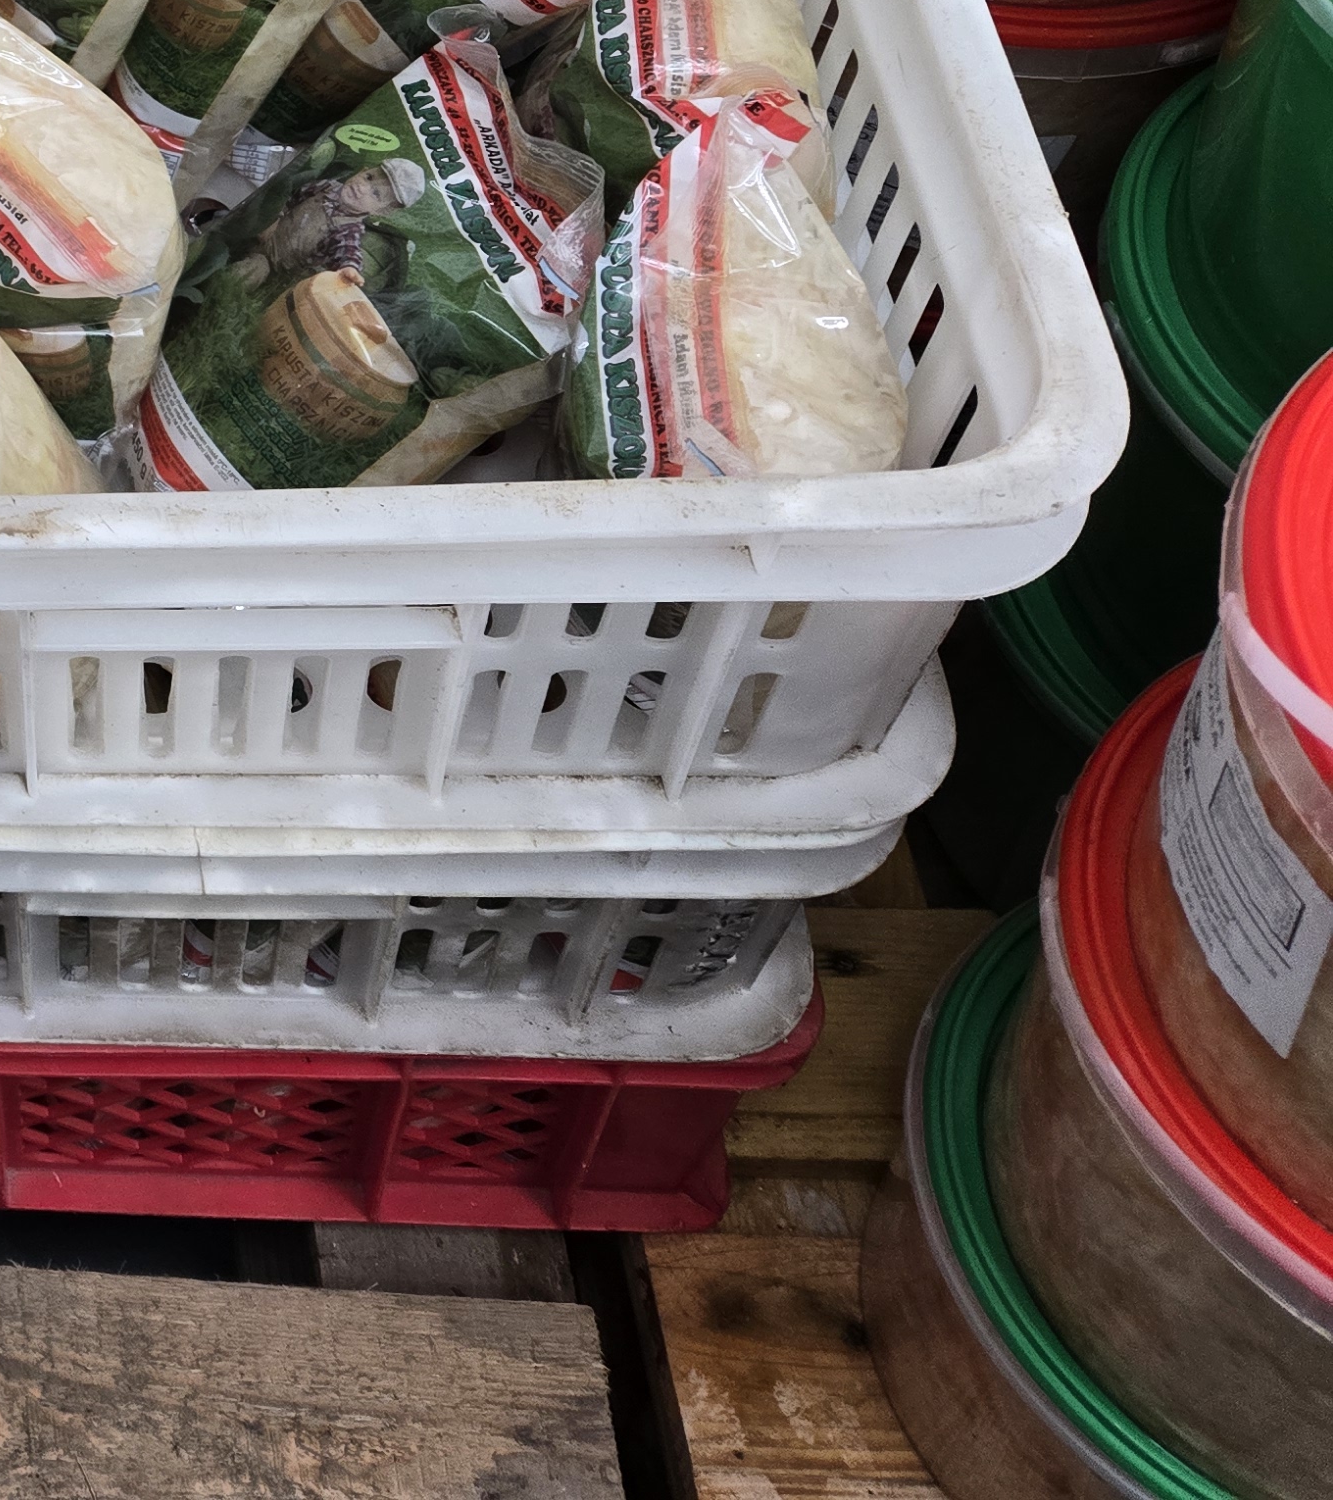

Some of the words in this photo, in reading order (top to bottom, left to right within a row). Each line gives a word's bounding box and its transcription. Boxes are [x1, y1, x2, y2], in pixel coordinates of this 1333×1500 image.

[401, 79, 466, 179] KAPUSTA
[272, 325, 320, 392] KAPUSTA
[323, 391, 386, 427] KISZONA
[139, 463, 148, 480] g
